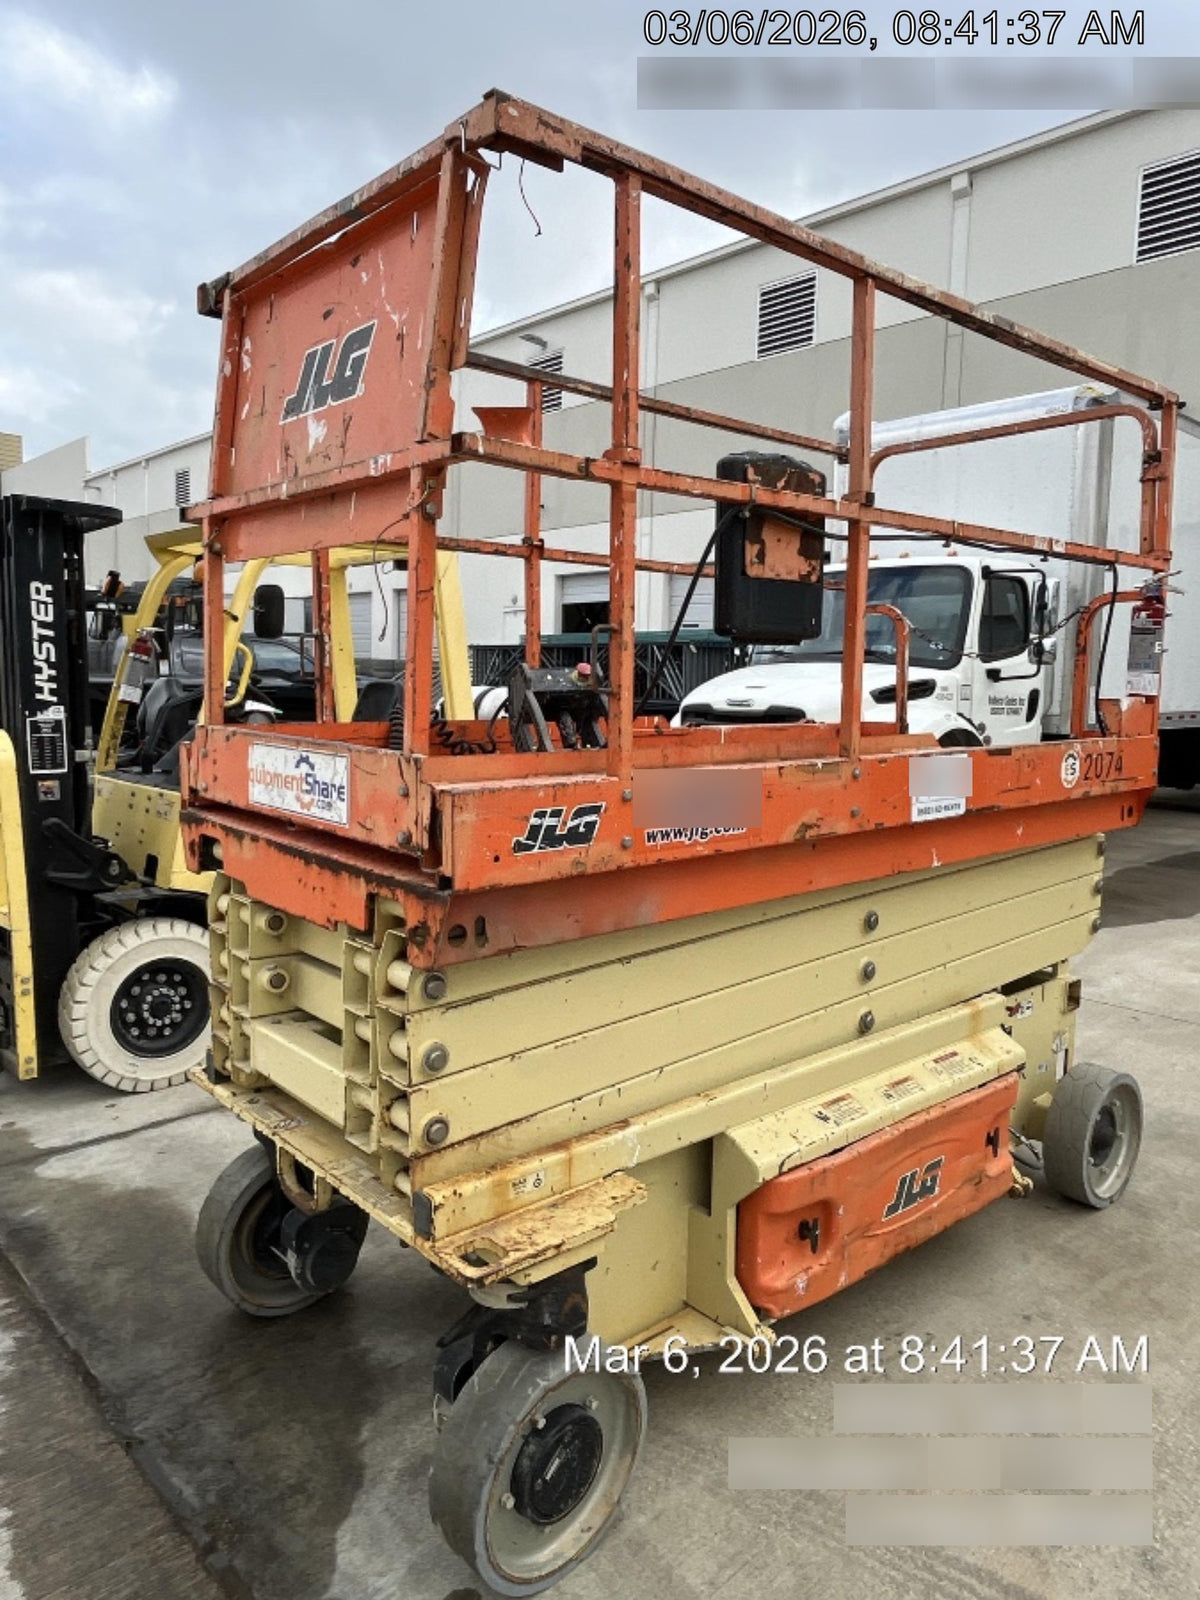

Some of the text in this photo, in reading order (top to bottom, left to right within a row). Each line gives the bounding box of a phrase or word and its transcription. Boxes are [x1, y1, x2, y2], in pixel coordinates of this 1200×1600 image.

[279, 319, 377, 425] JLG
[29, 580, 58, 703] HYSTER
[249, 765, 346, 803] quipmentShare
[512, 801, 606, 855] JLG
[645, 827, 746, 844] www.jlg.
[881, 1154, 945, 1222] JLG
